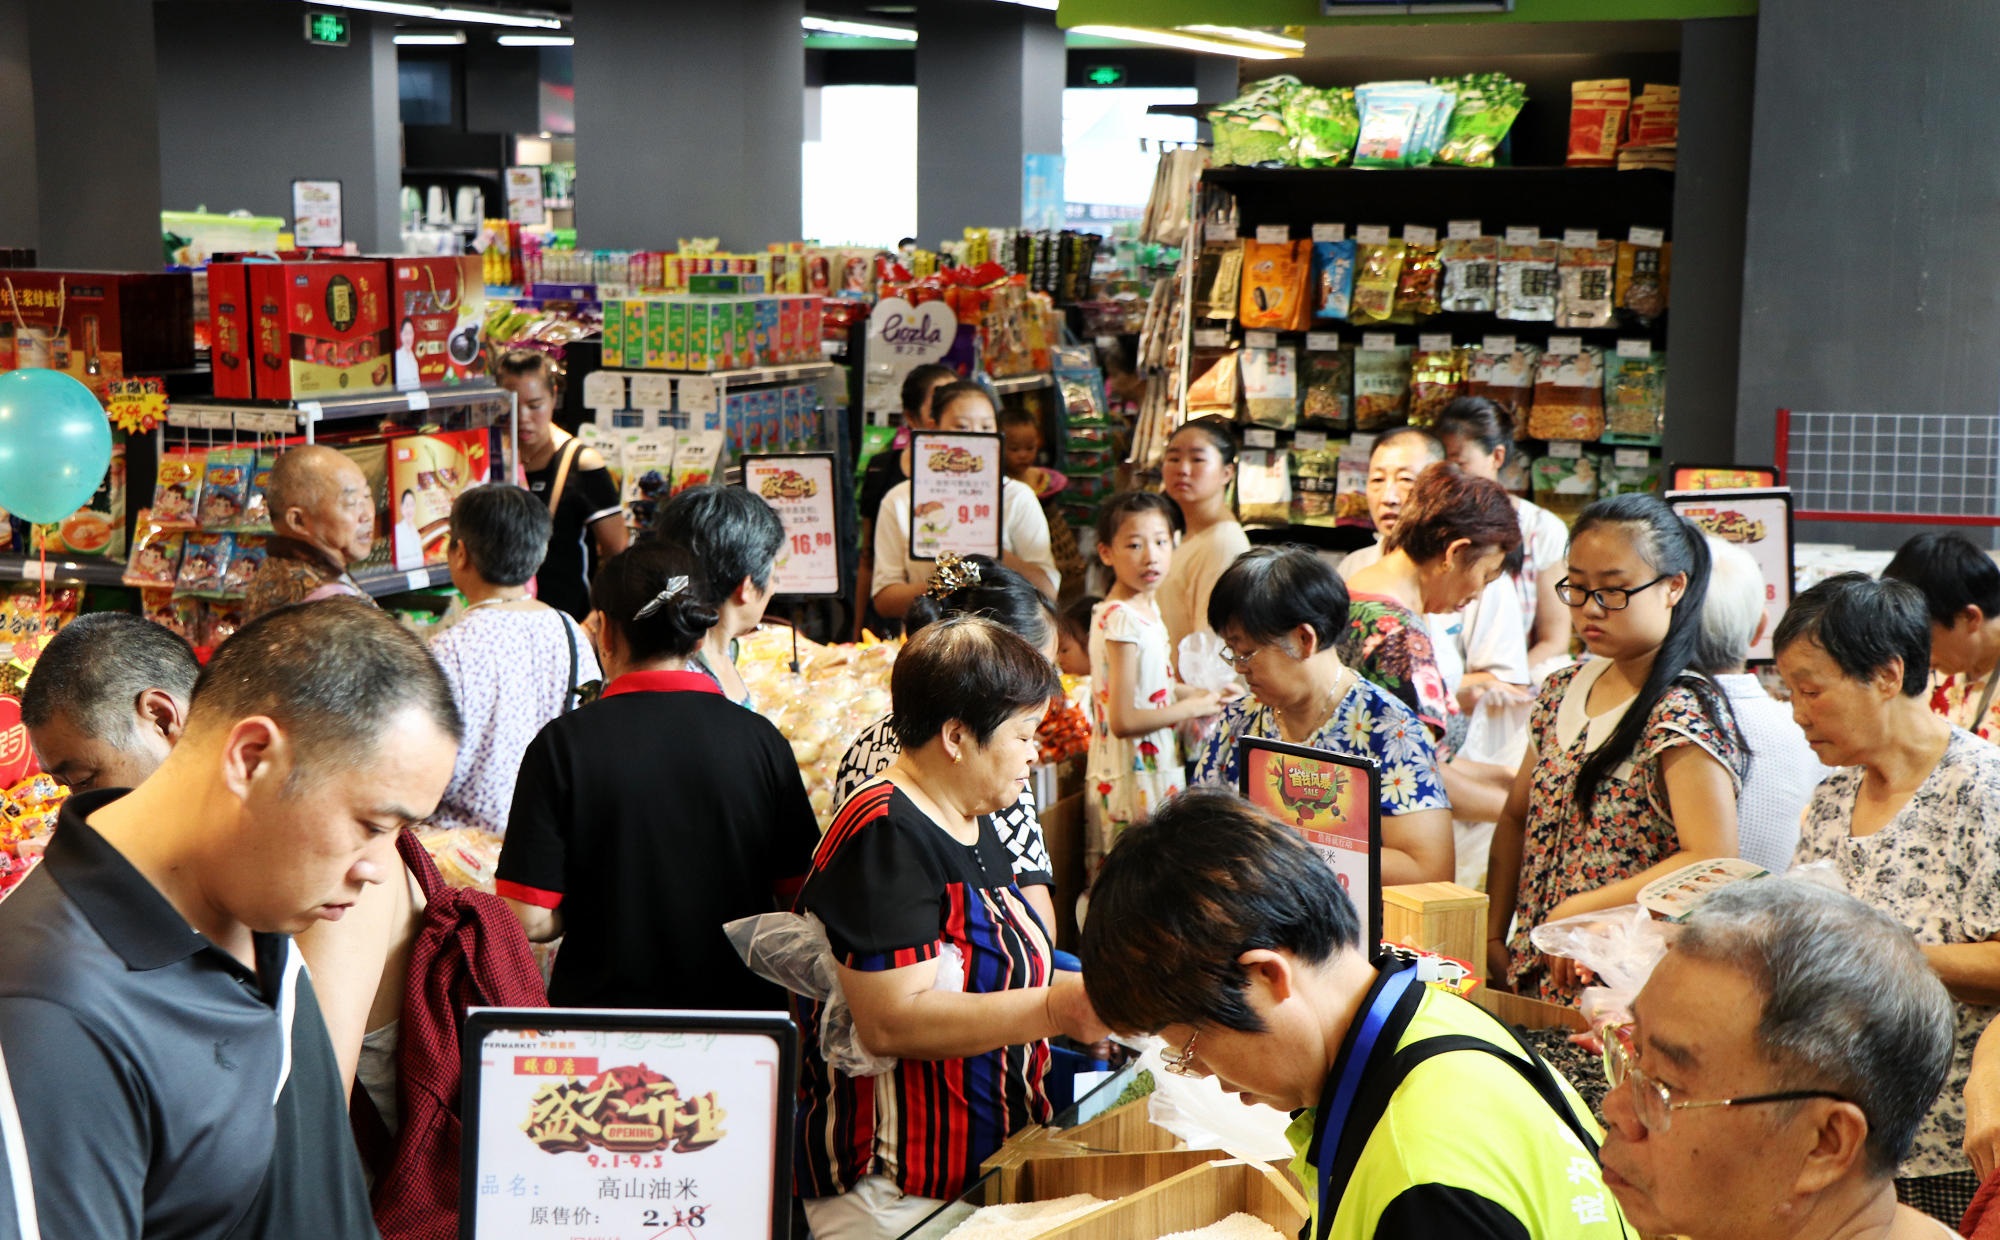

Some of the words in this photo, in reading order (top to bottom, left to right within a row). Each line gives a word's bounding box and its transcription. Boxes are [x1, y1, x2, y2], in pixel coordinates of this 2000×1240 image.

[1303, 788, 1319, 797] SALE
[519, 1071, 728, 1144] 盛大开业
[608, 1127, 654, 1139] OPENING
[598, 1177, 699, 1200] 高山油米
[642, 1205, 706, 1228] 2.18
